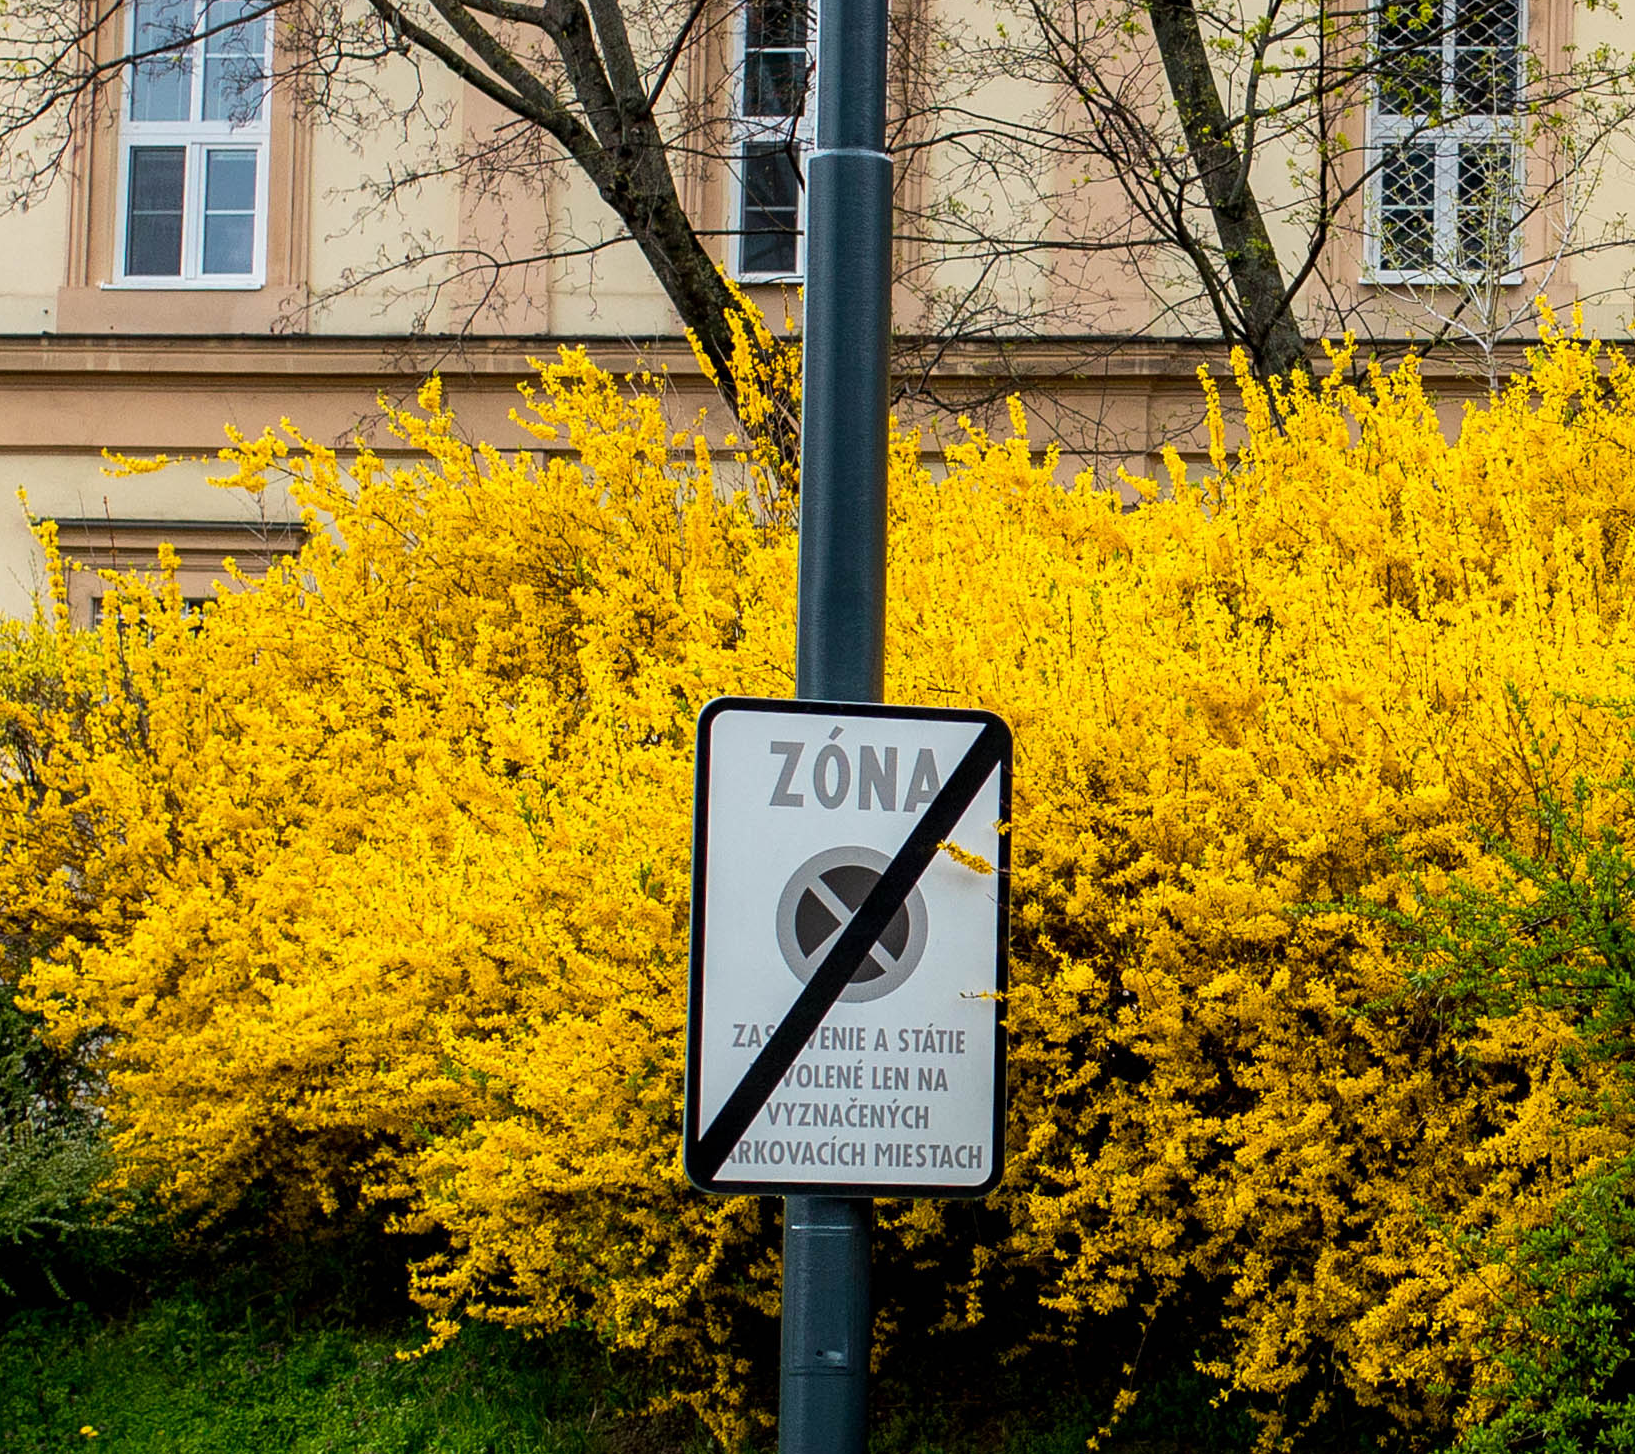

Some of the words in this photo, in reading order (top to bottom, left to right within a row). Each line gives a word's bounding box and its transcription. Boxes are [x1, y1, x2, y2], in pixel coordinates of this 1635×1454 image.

[769, 725, 942, 813] ZÓNA
[732, 1023, 866, 1052] ZASVENIE
[874, 1027, 889, 1052] A
[898, 1022, 966, 1054] STÁTIE
[749, 1058, 864, 1090] VOLENÉ
[871, 1065, 910, 1091] LEN
[917, 1066, 949, 1092] NA
[765, 1096, 930, 1130] VYZNAČENÝCH
[874, 1142, 983, 1170] MIESTACH
